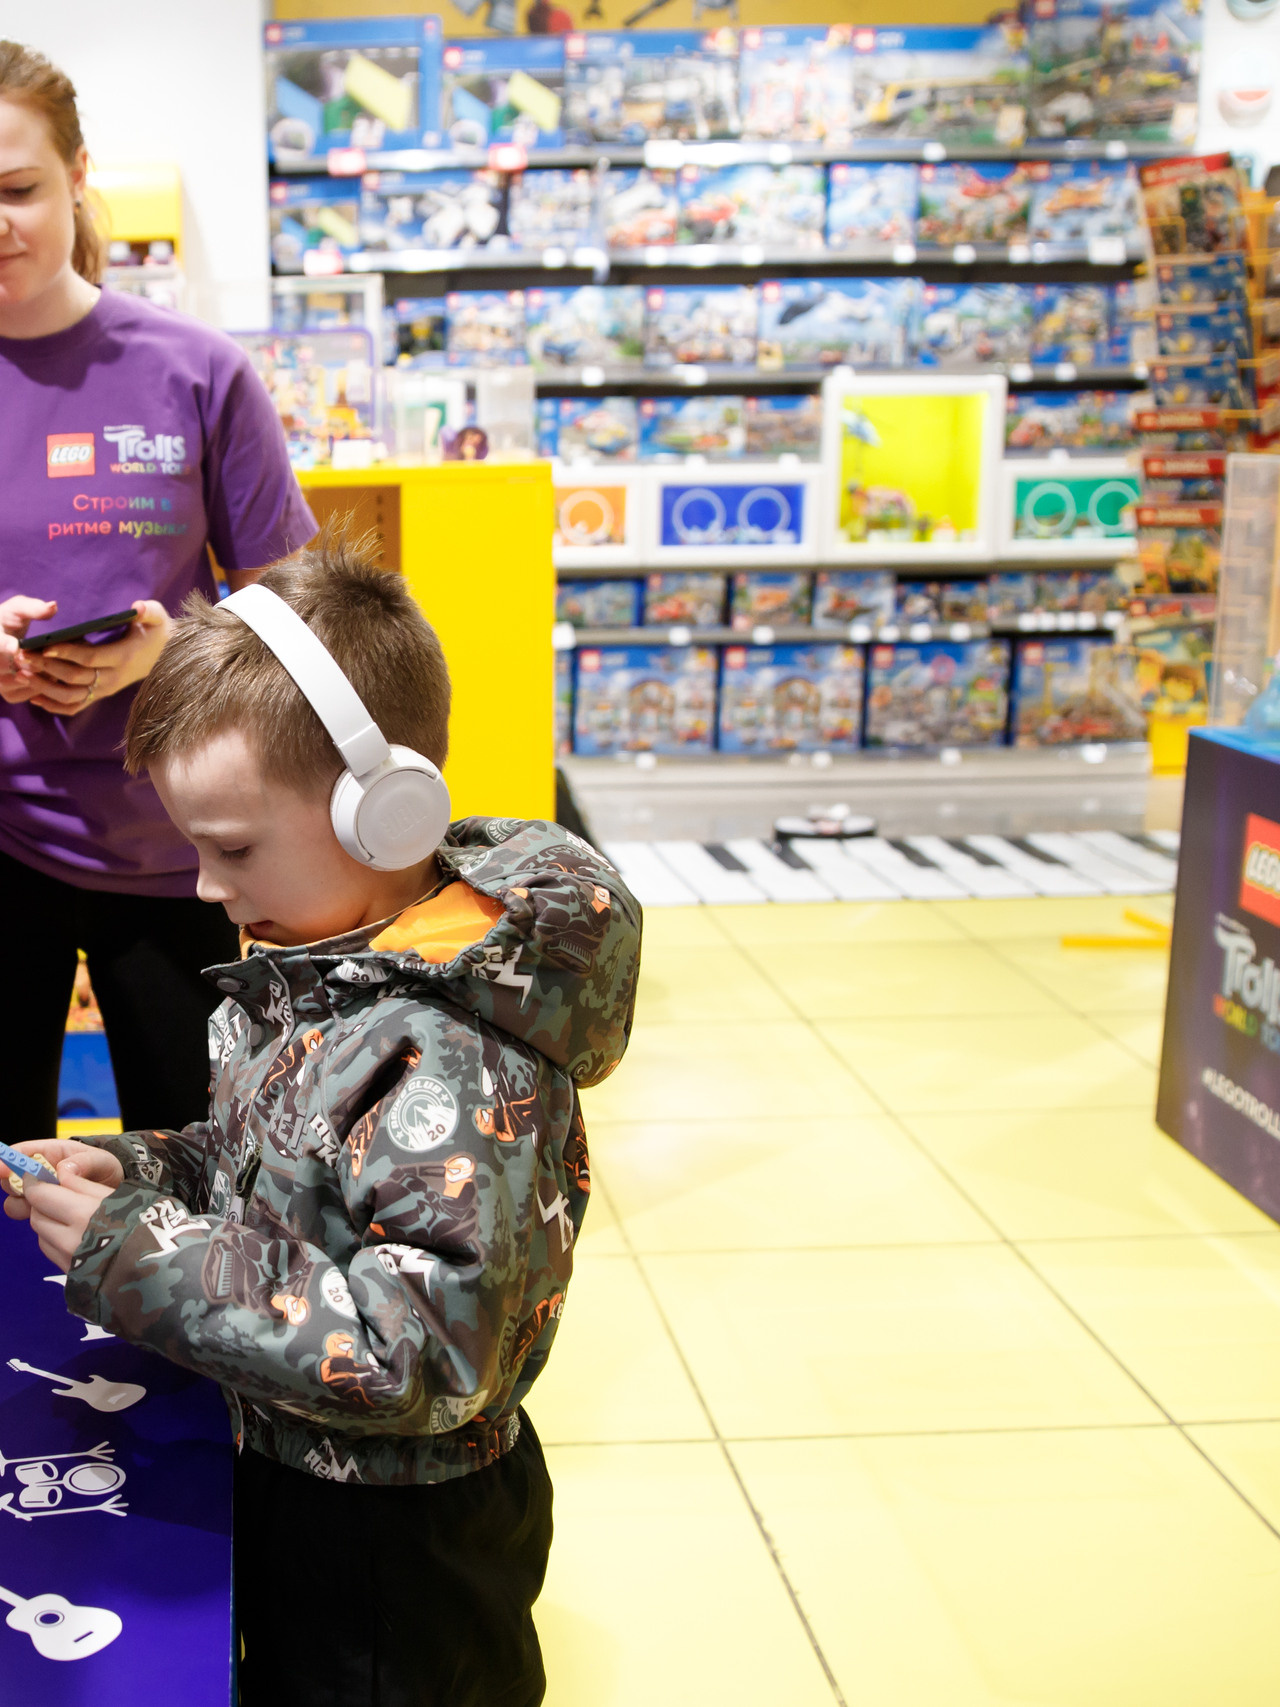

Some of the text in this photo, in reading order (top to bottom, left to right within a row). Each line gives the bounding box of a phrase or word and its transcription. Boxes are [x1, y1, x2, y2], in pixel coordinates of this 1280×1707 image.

[50, 445, 92, 464] LEGO
[73, 494, 154, 513] Строим
[48, 521, 112, 540] ритме
[351, 971, 370, 983] 20
[1214, 925, 1280, 1024] Troll
[407, 1080, 442, 1094] CLUB
[427, 1123, 447, 1142] 20
[141, 1163, 154, 1180] 20
[328, 1287, 344, 1303] 20
